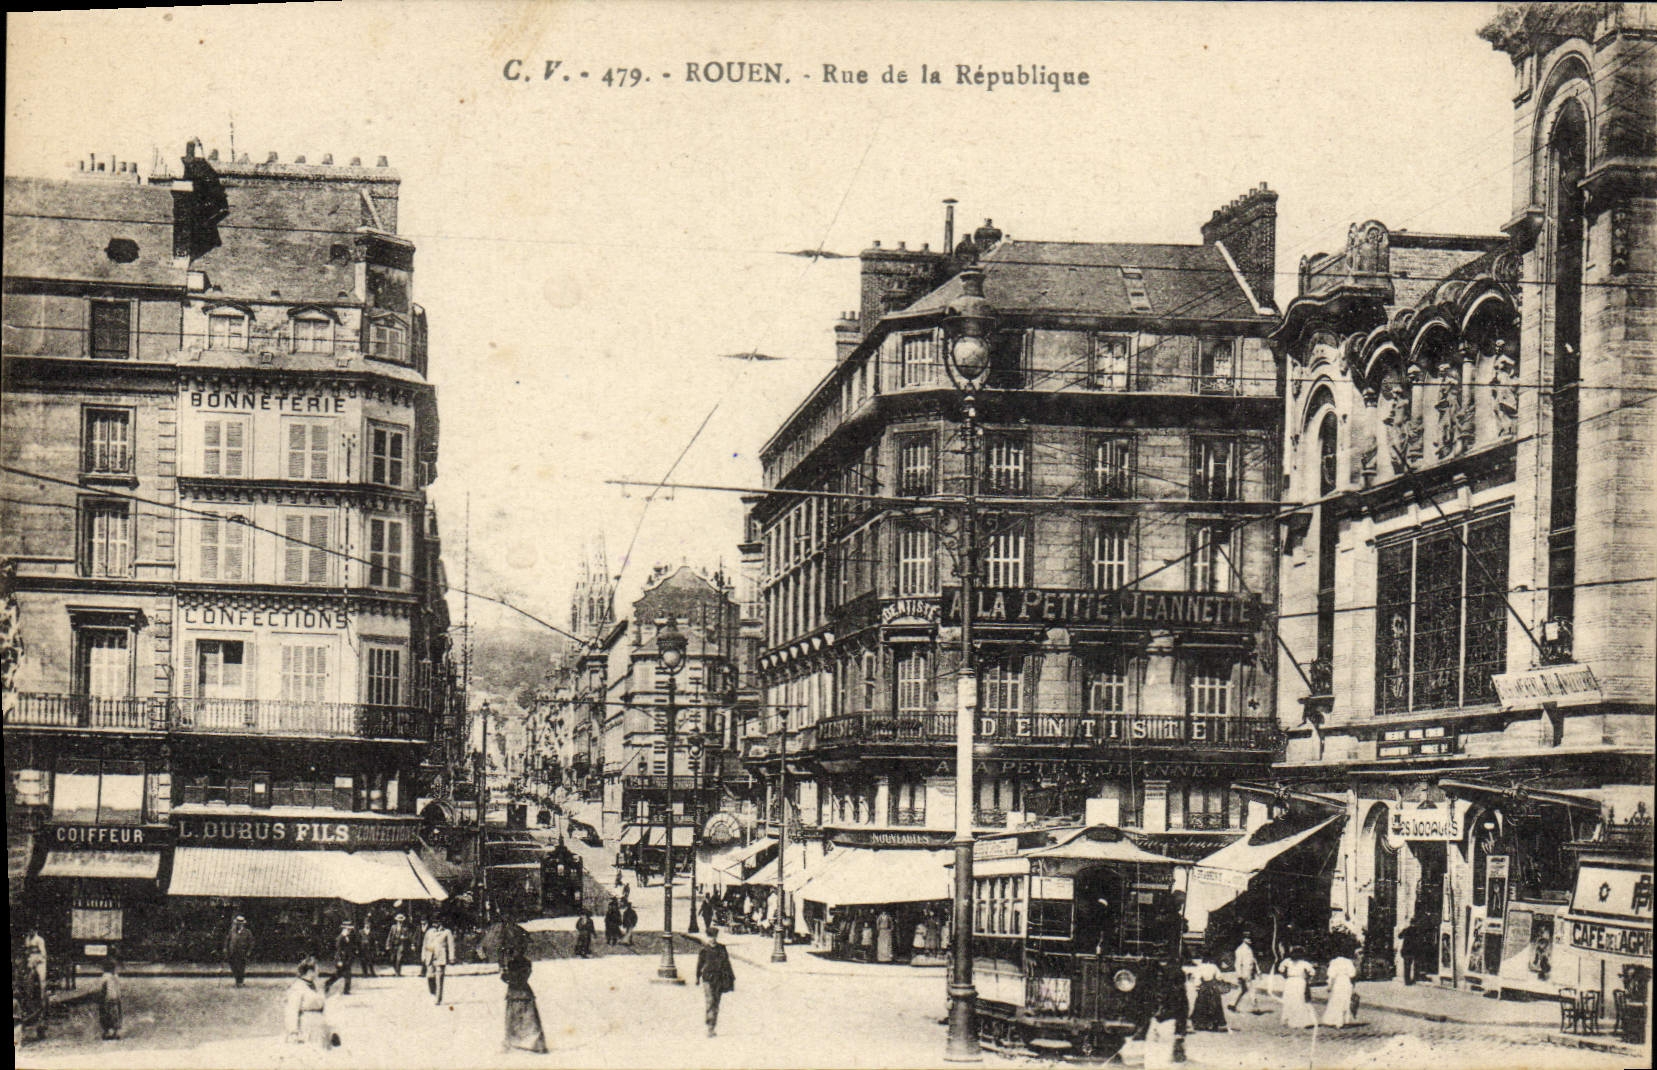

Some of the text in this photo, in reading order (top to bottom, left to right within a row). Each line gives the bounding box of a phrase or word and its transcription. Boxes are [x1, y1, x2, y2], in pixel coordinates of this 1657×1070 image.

[190, 391, 347, 414] BONNETERIE
[881, 600, 941, 625] DENTISTE
[949, 588, 1252, 625] A LA PETITE JEANNETTE
[185, 607, 349, 630] CONFECTIONS
[979, 716, 1208, 741] DENTISTE
[56, 826, 145, 845] COIFFEUR
[178, 820, 200, 839] L.
[203, 821, 287, 841] DUBUS
[295, 822, 351, 843] FILS
